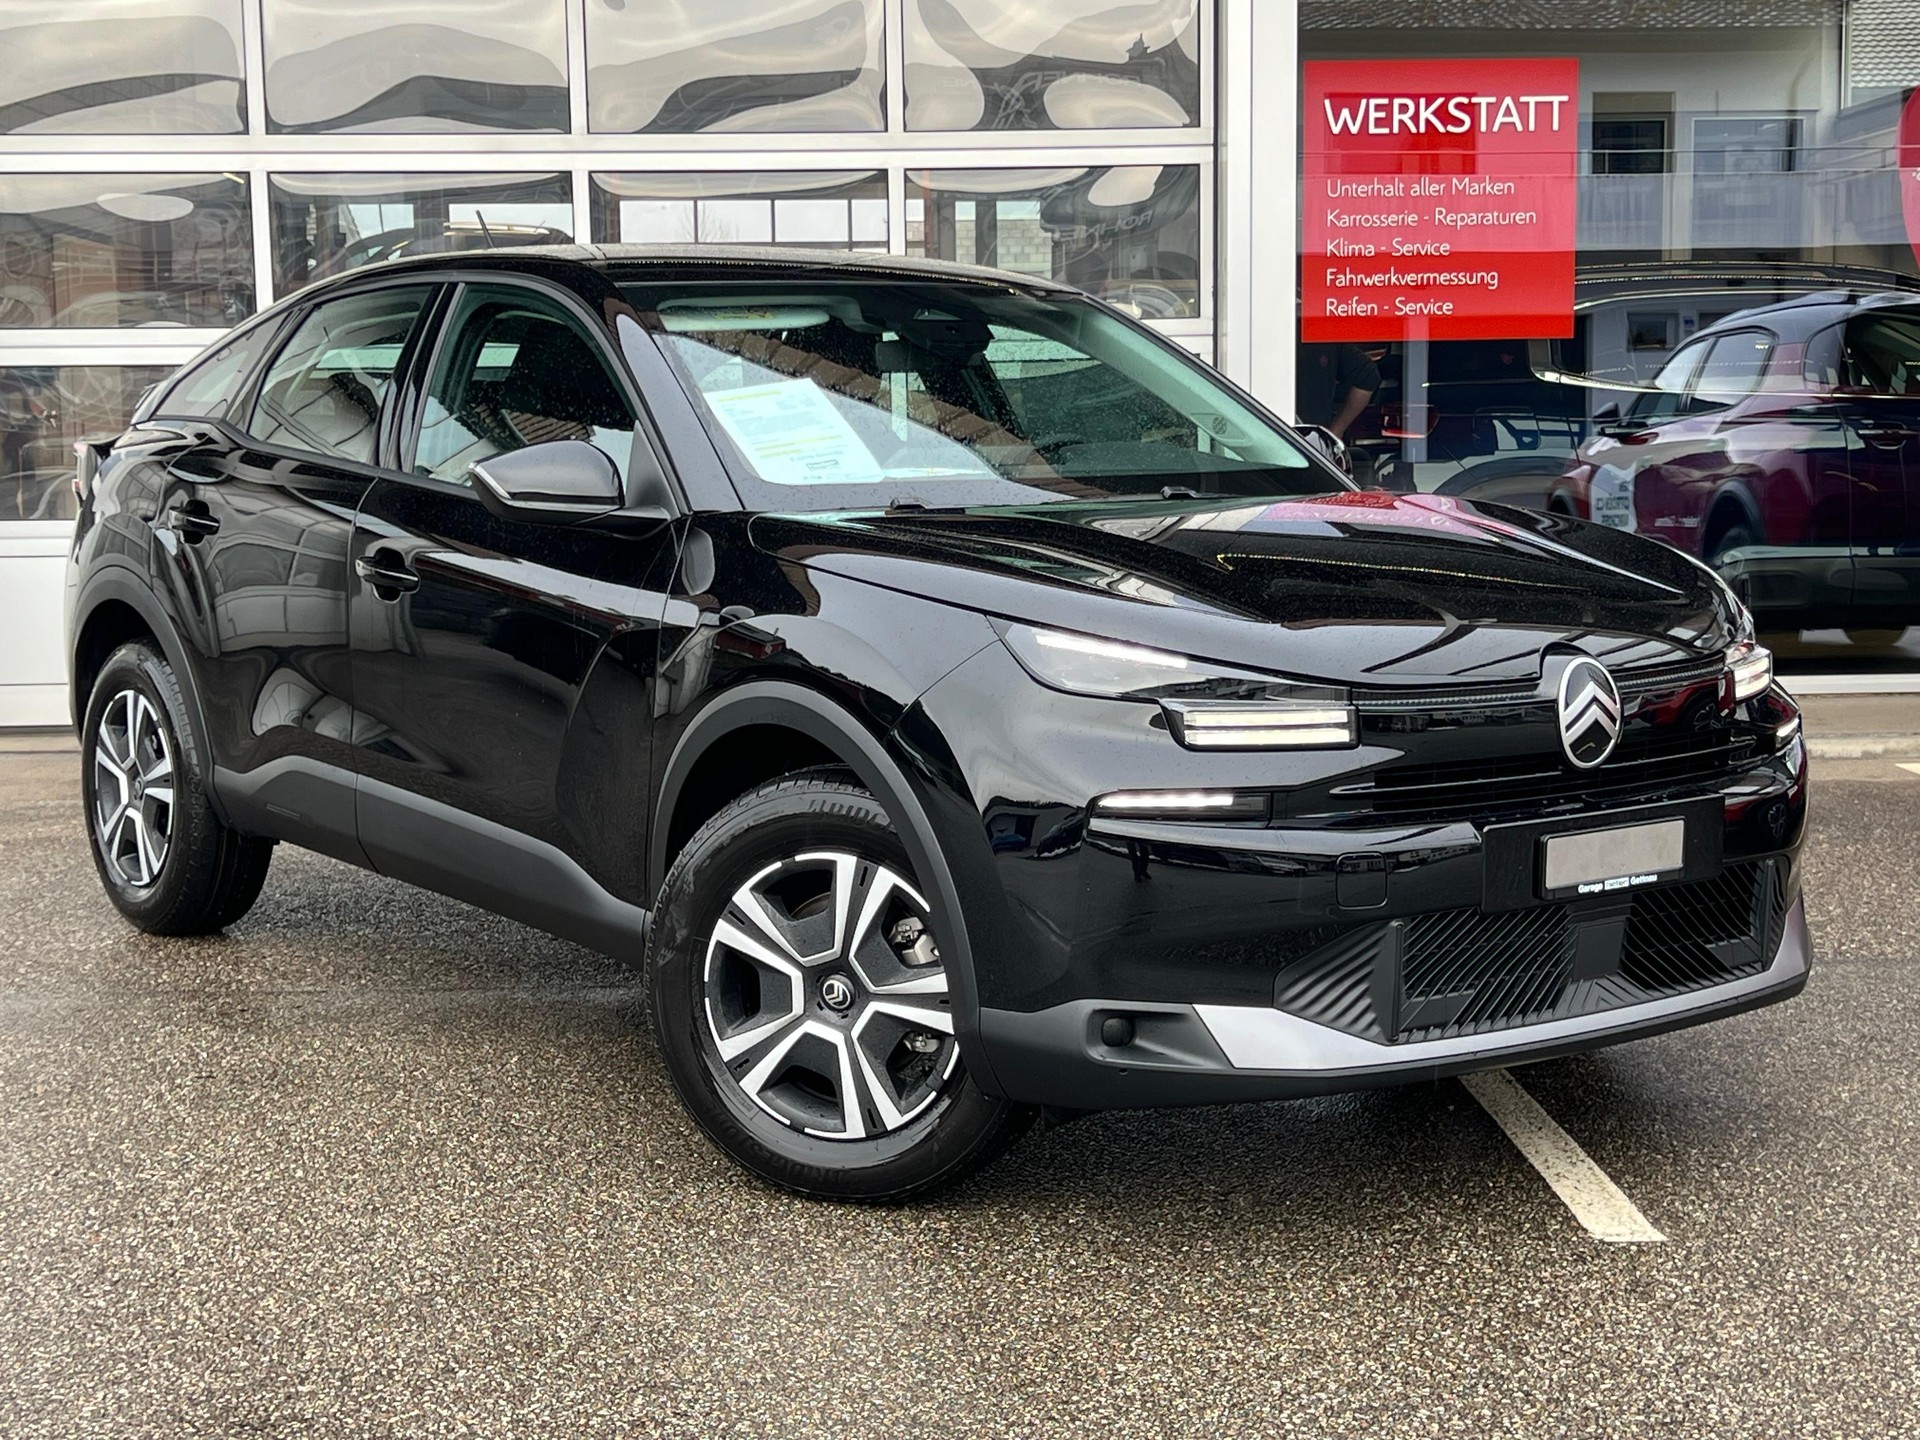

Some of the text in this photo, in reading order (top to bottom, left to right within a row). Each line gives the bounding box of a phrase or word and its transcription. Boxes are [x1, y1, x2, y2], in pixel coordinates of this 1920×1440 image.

[1324, 96, 1568, 134] WERKSTATT
[1328, 176, 1514, 197] Unterhalt aller Marken
[1328, 210, 1418, 227] Karrosserie
[1436, 208, 1536, 229] Reparaturen
[1327, 238, 1374, 256] Klima
[1392, 238, 1450, 255] Service
[1327, 267, 1497, 289] Fahrwerkvermessung
[1327, 297, 1377, 316] Reifen
[1395, 297, 1453, 315] Service
